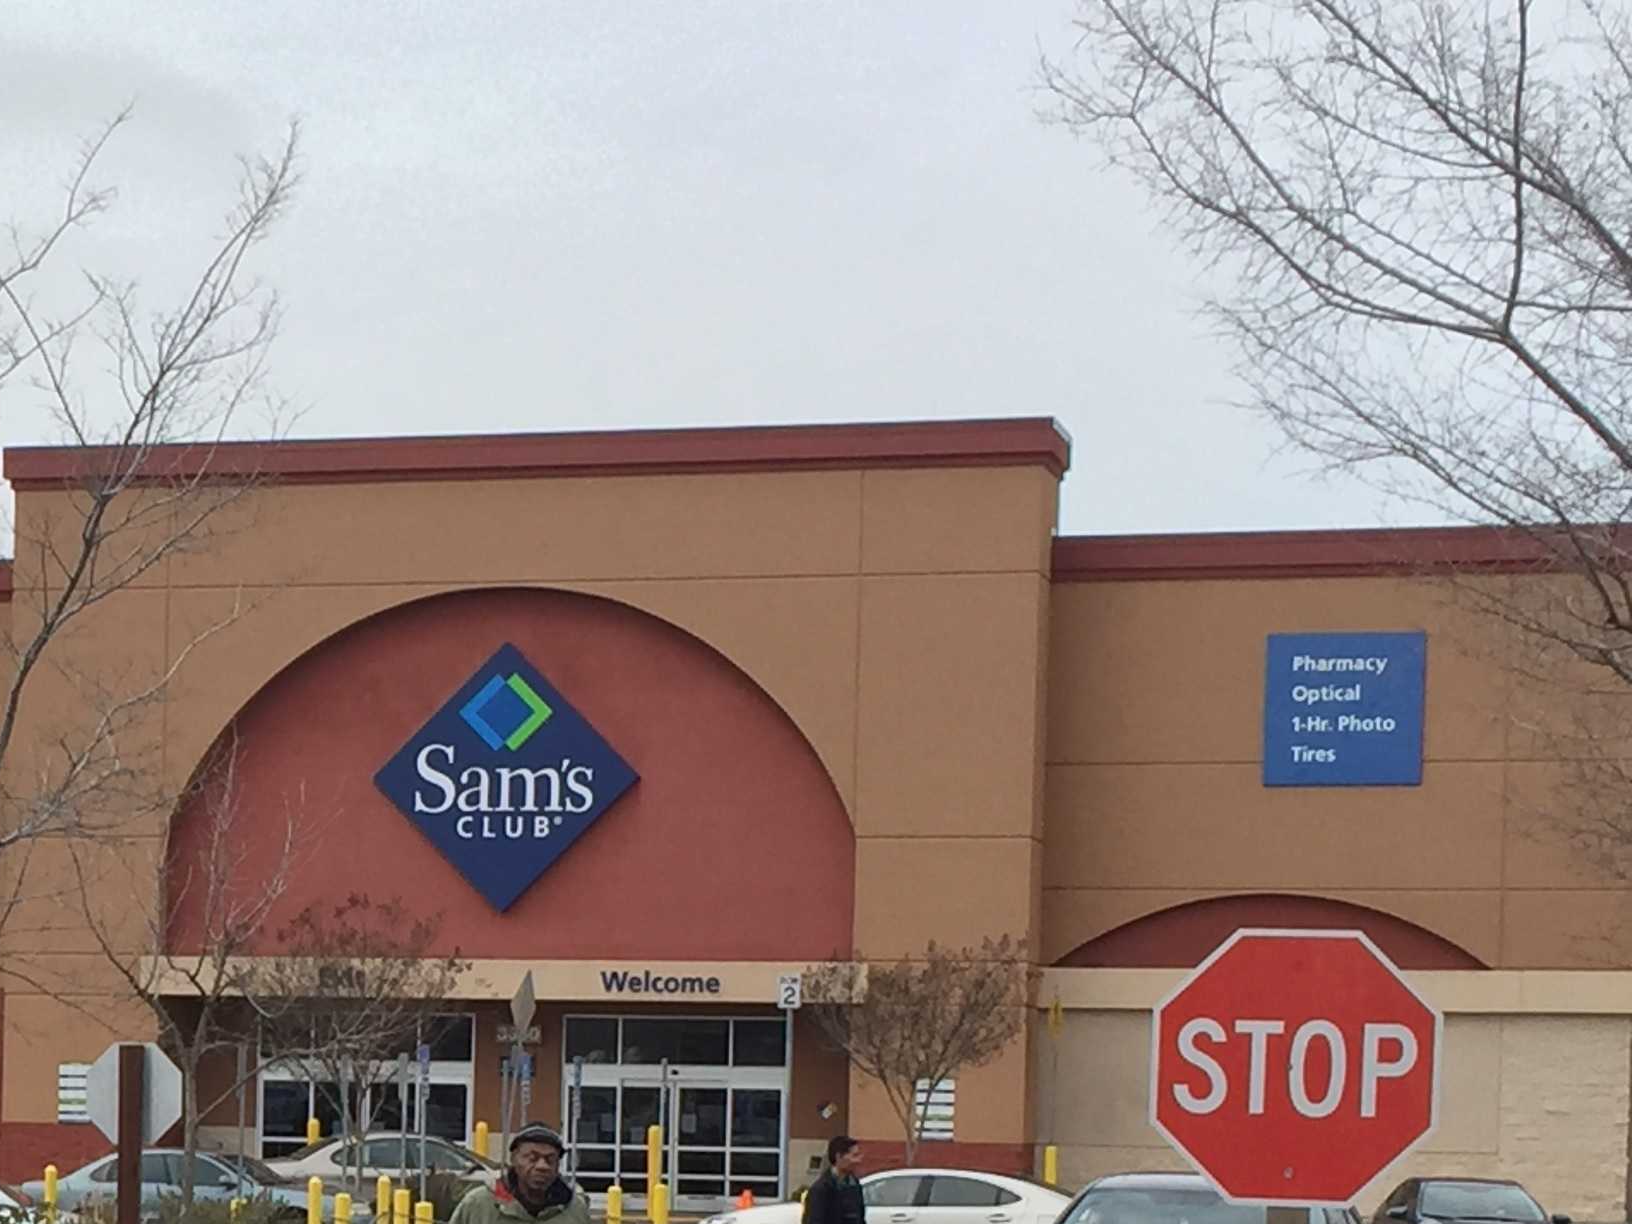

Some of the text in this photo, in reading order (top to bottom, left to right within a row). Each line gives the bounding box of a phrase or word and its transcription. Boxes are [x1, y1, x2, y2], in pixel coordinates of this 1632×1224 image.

[1291, 655, 1388, 675] Pharmacy
[1291, 684, 1361, 705] Optical
[1291, 715, 1396, 732] 1-Hr. Photo
[1290, 745, 1337, 763] Tires
[414, 743, 594, 814] Sam's
[600, 970, 721, 993] Welcome
[783, 986, 796, 1005] 2
[1173, 1017, 1418, 1118] STOP
